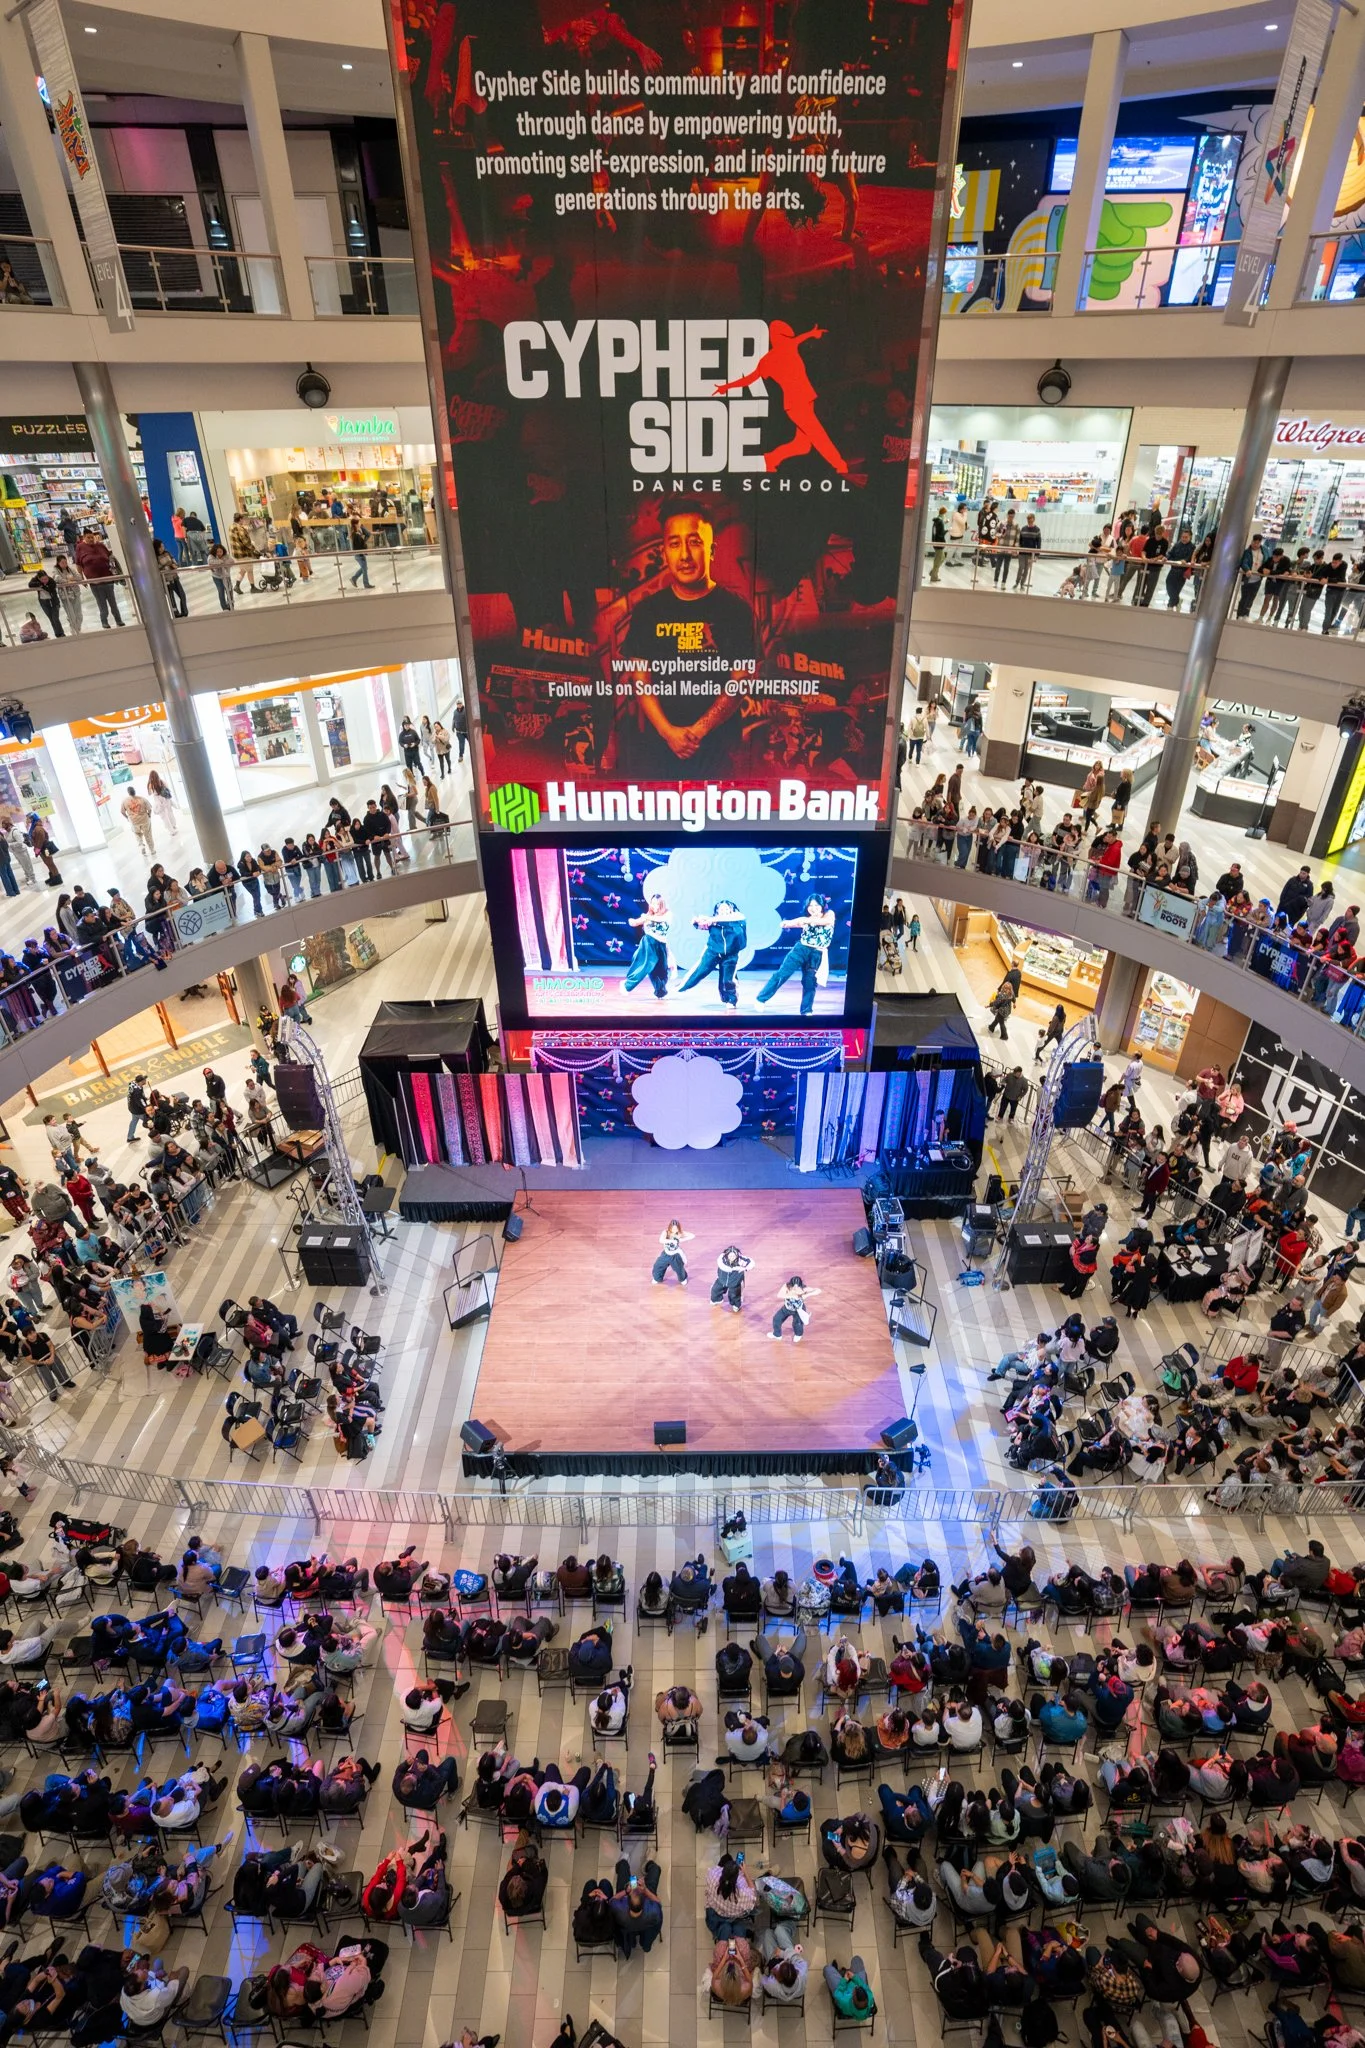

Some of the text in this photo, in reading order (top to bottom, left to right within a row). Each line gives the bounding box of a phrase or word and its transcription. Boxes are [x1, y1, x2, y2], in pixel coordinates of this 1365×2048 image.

[474, 68, 887, 102] Cypher Side builds community and confidence
[516, 109, 842, 142] through dance by empowering youth,
[475, 148, 886, 180] promoting self-expression, and inspiring future
[554, 186, 805, 216] generations through the arts.
[94, 262, 114, 281] LEVEL
[1238, 254, 1261, 274] LEVEL
[115, 261, 133, 330] 4
[1242, 262, 1267, 327] 4
[503, 319, 769, 399] CYPHER
[11, 423, 88, 436] PUZZLES
[337, 414, 397, 437] jamba
[629, 399, 769, 474] SIDE
[633, 479, 850, 492] DANCE SCHOOL
[656, 622, 704, 637] CYPHER
[677, 636, 703, 650] SIDE
[611, 655, 756, 676] www.cypherside.org
[793, 652, 845, 681] Bank
[547, 679, 820, 698] Follow Us on Social Media @CYPHERSIDE
[546, 779, 879, 832] Huntington Bank
[202, 901, 226, 915] CAAL
[1160, 913, 1187, 929] ROOTS
[1258, 943, 1294, 965] CYPHER
[64, 955, 99, 981] CYPHER
[84, 962, 103, 981] SIDE
[1270, 960, 1292, 977] SIDE
[532, 977, 605, 990] HMONG
[62, 1032, 230, 1107] BARNES & NOBLE
